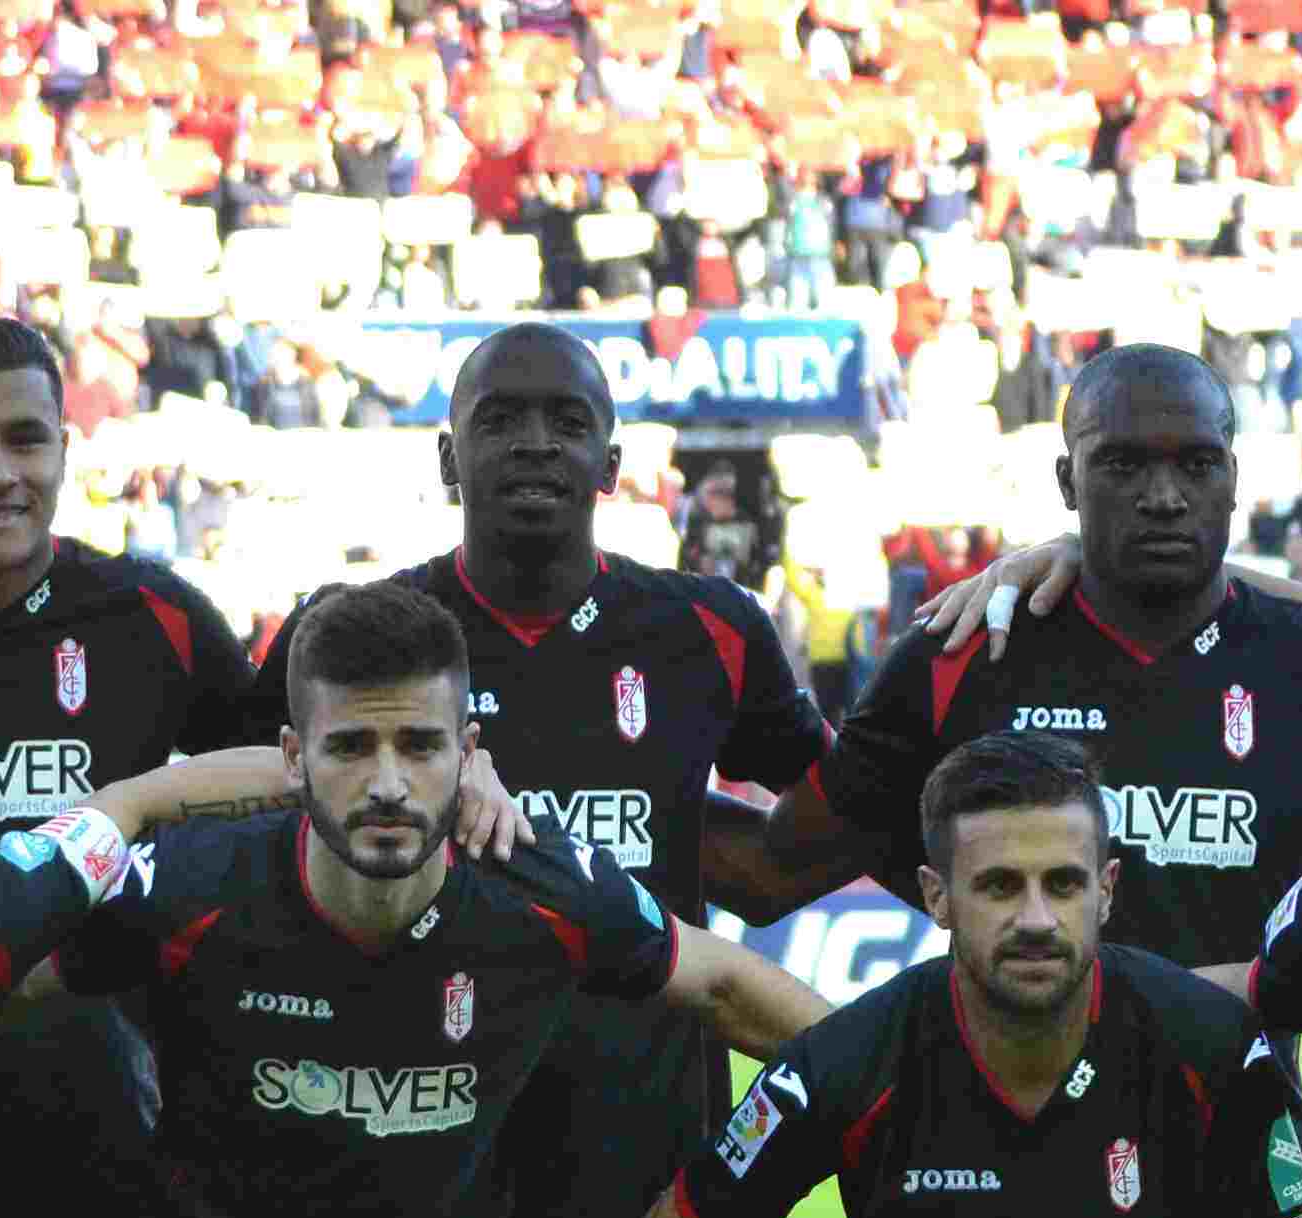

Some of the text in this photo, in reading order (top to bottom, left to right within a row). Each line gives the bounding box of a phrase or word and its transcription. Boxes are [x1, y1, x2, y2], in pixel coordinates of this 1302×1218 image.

[571, 597, 599, 632] GCF
[1194, 620, 1221, 655] GCF
[1012, 706, 1107, 731] Joma
[1103, 788, 1255, 845] LVER
[238, 989, 334, 1019] Joma
[256, 1061, 474, 1115] SOLVER
[1066, 1059, 1096, 1098] GCF
[902, 1168, 1001, 1193] Joma
